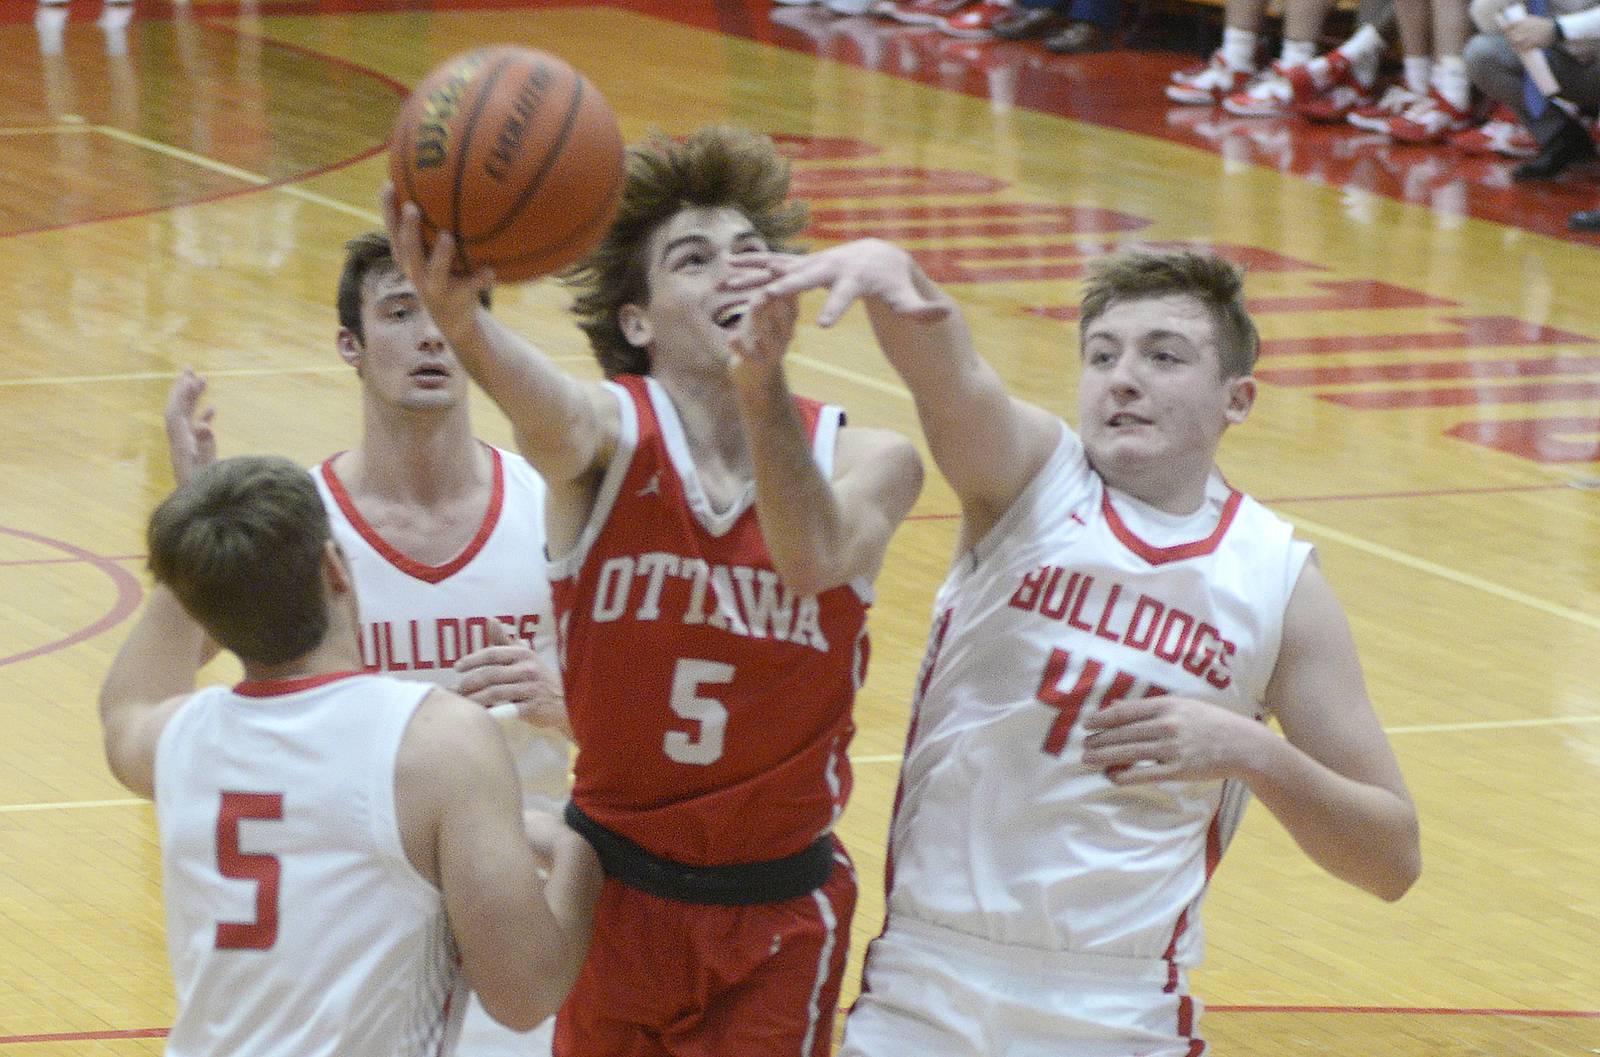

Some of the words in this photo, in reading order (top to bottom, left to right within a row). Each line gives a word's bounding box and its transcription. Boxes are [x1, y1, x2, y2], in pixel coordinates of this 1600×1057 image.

[357, 613, 541, 673] ULLDOS
[592, 551, 830, 653] OTTAWA
[1008, 565, 1237, 690] BULLDOGS
[662, 657, 737, 766] 5
[1036, 647, 1170, 758] 4
[214, 789, 285, 951] 5
